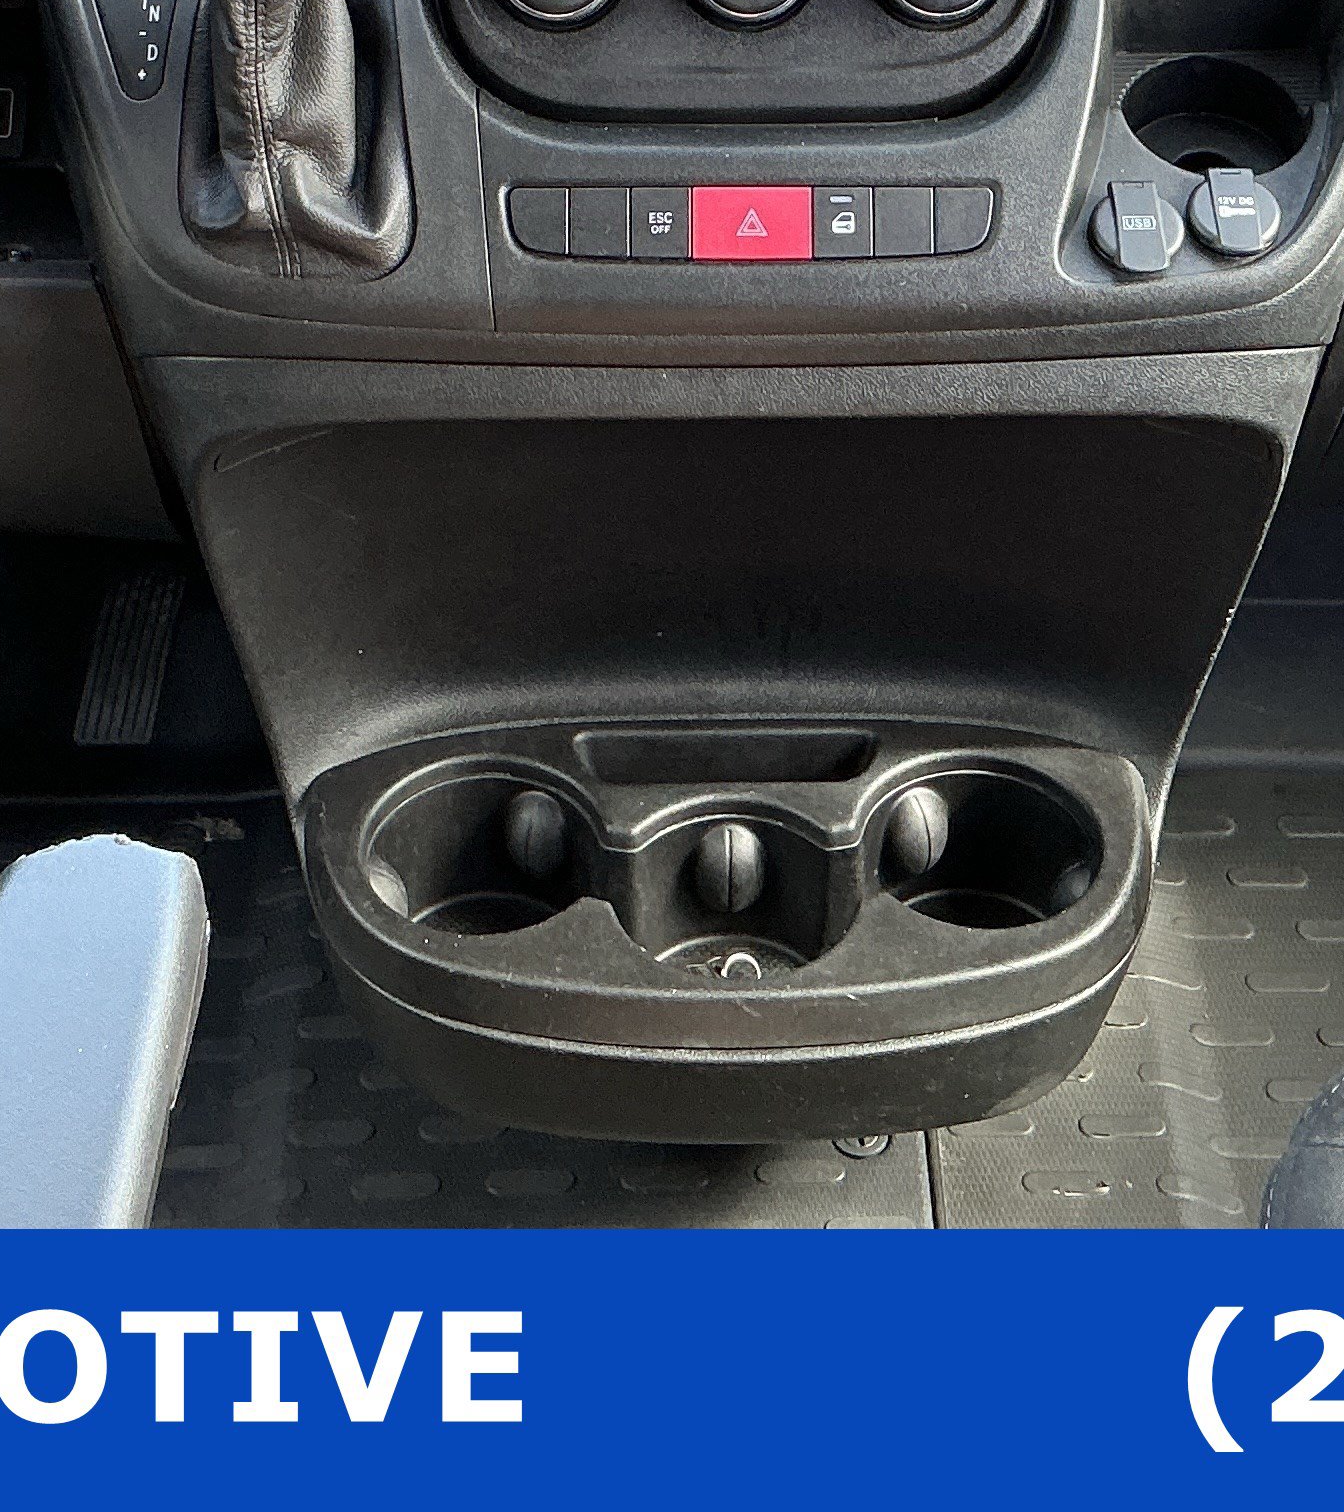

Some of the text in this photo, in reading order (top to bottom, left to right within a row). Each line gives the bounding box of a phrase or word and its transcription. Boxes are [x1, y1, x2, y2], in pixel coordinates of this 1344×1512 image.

[148, 5, 161, 23] N
[146, 43, 160, 62] D
[1217, 196, 1237, 206] 12V
[647, 211, 674, 224] ESC
[1123, 217, 1155, 229] USB
[650, 224, 672, 235] OFF
